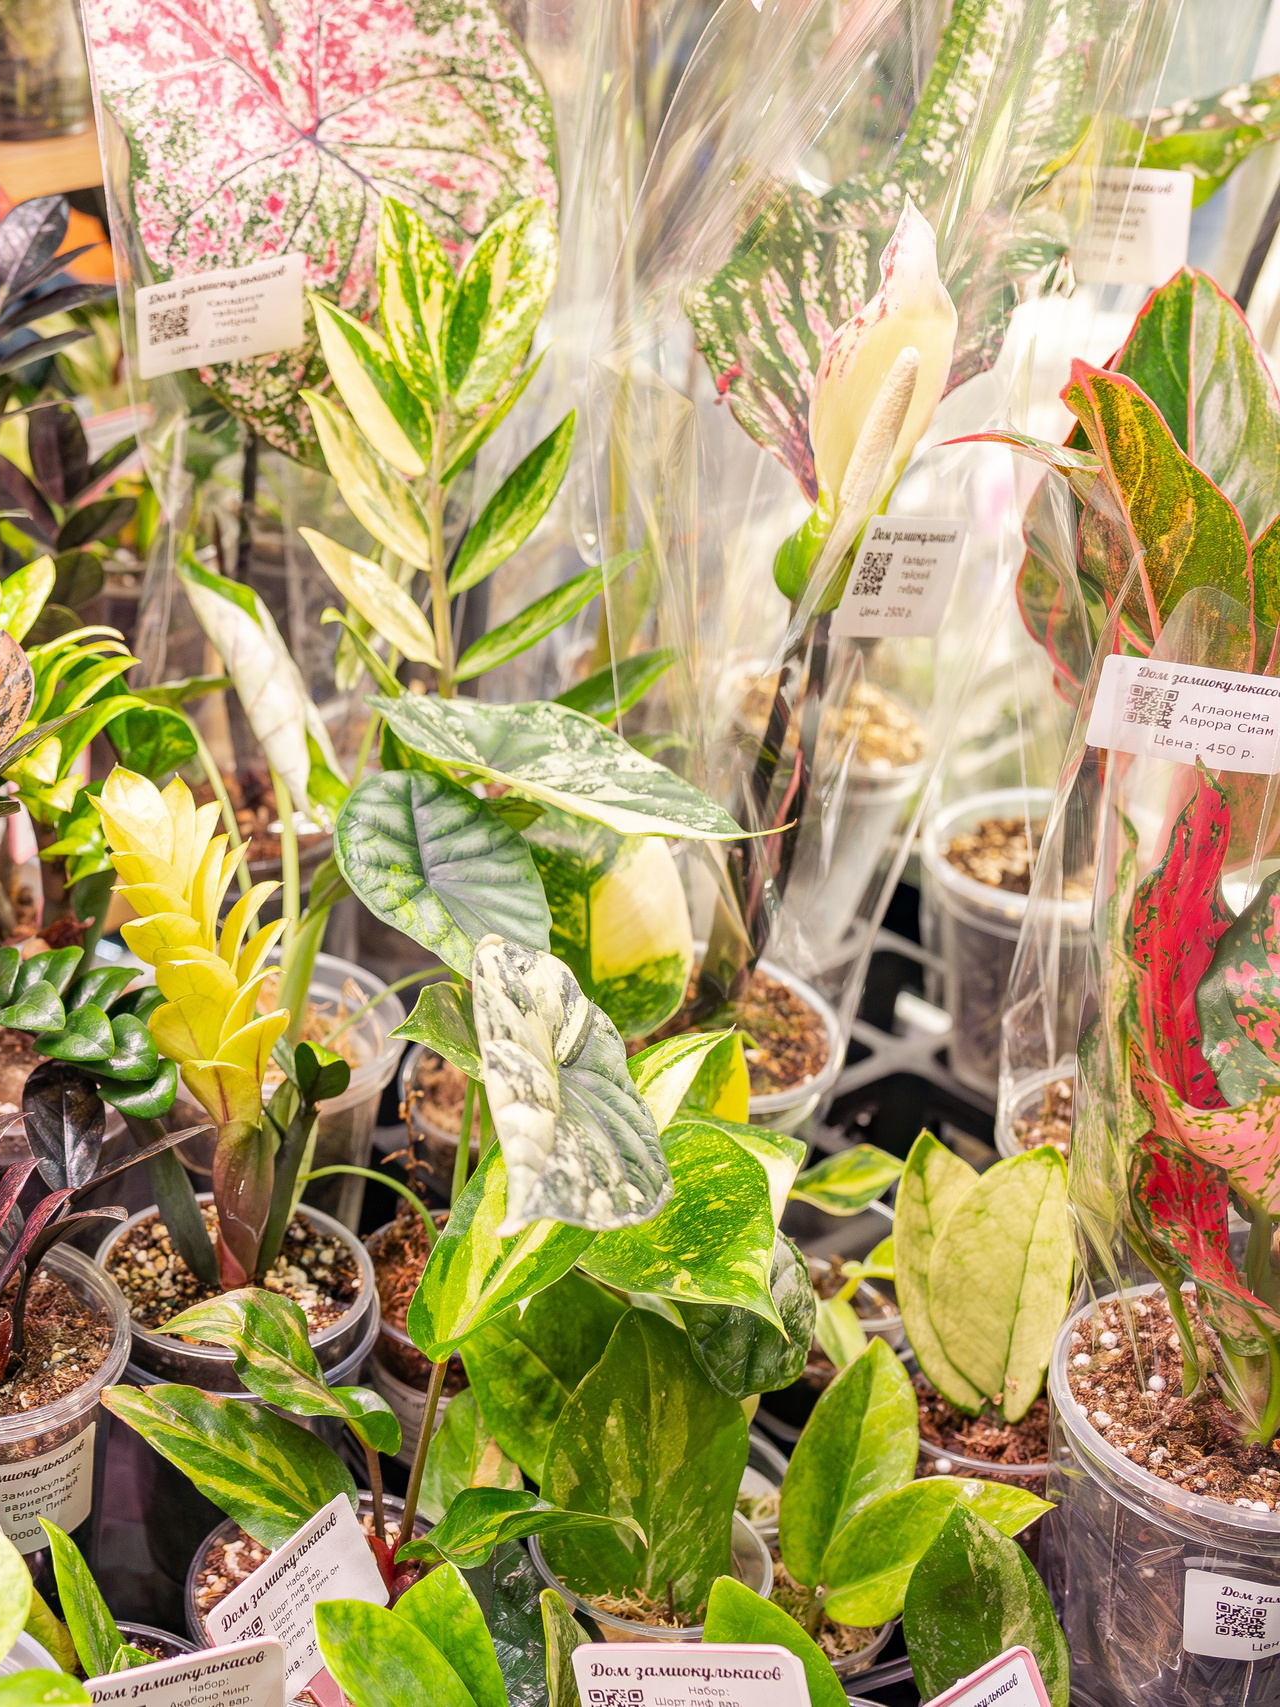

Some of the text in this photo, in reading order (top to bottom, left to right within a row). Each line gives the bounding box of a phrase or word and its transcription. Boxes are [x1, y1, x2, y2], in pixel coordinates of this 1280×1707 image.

[1137, 666, 1169, 681] Дом
[1191, 702, 1270, 723] Аглаонема
[1179, 714, 1274, 737] Аврора Сиам
[1154, 734, 1255, 761] Цена: 450 р.
[1, 1463, 82, 1502] Замиокулькас
[5, 1476, 79, 1513] вариегатный
[12, 1492, 73, 1522] Блэк Пинк
[5, 1526, 42, 1541] 0000
[221, 1512, 338, 1633] Дом замиокулькасов
[285, 1563, 312, 1591] Набор:
[268, 1568, 323, 1622] Шорт лиф вар.
[273, 1608, 294, 1632] Шорт
[295, 1593, 310, 1612] лиф
[311, 1576, 330, 1595] Грин
[330, 1564, 340, 1576] он
[1221, 1586, 1253, 1600] Дом
[90, 1650, 266, 1705] Дом замиокулькасов
[591, 1663, 782, 1681] Дом замиокулькасов
[188, 1677, 229, 1694] Набор:
[222, 1684, 250, 1697] минт
[688, 1686, 730, 1697] Набор:
[229, 1696, 253, 1707] вар.
[654, 1697, 686, 1707] Шорт
[691, 1698, 714, 1707] лиф
